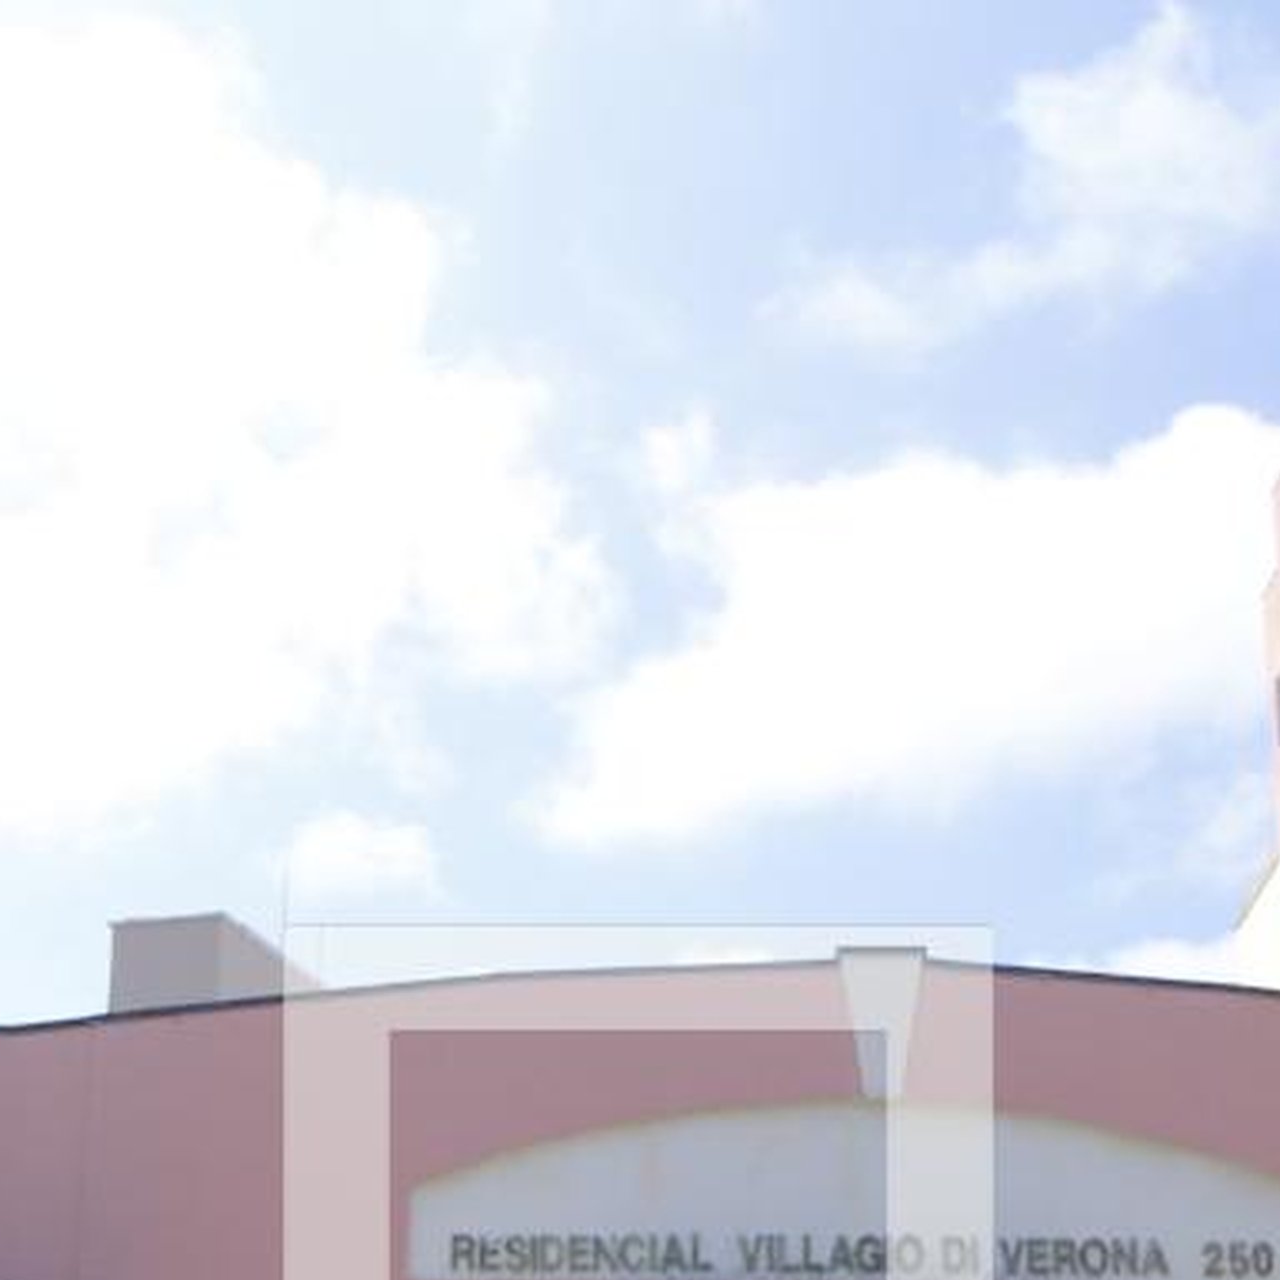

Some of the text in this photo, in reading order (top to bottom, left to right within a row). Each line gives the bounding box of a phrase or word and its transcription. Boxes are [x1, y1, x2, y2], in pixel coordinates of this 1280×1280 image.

[451, 1232, 714, 1274] RESIDENCIAL
[940, 1235, 981, 1276] DI
[997, 1236, 1169, 1278] VERONA
[1201, 1240, 1275, 1279] 250
